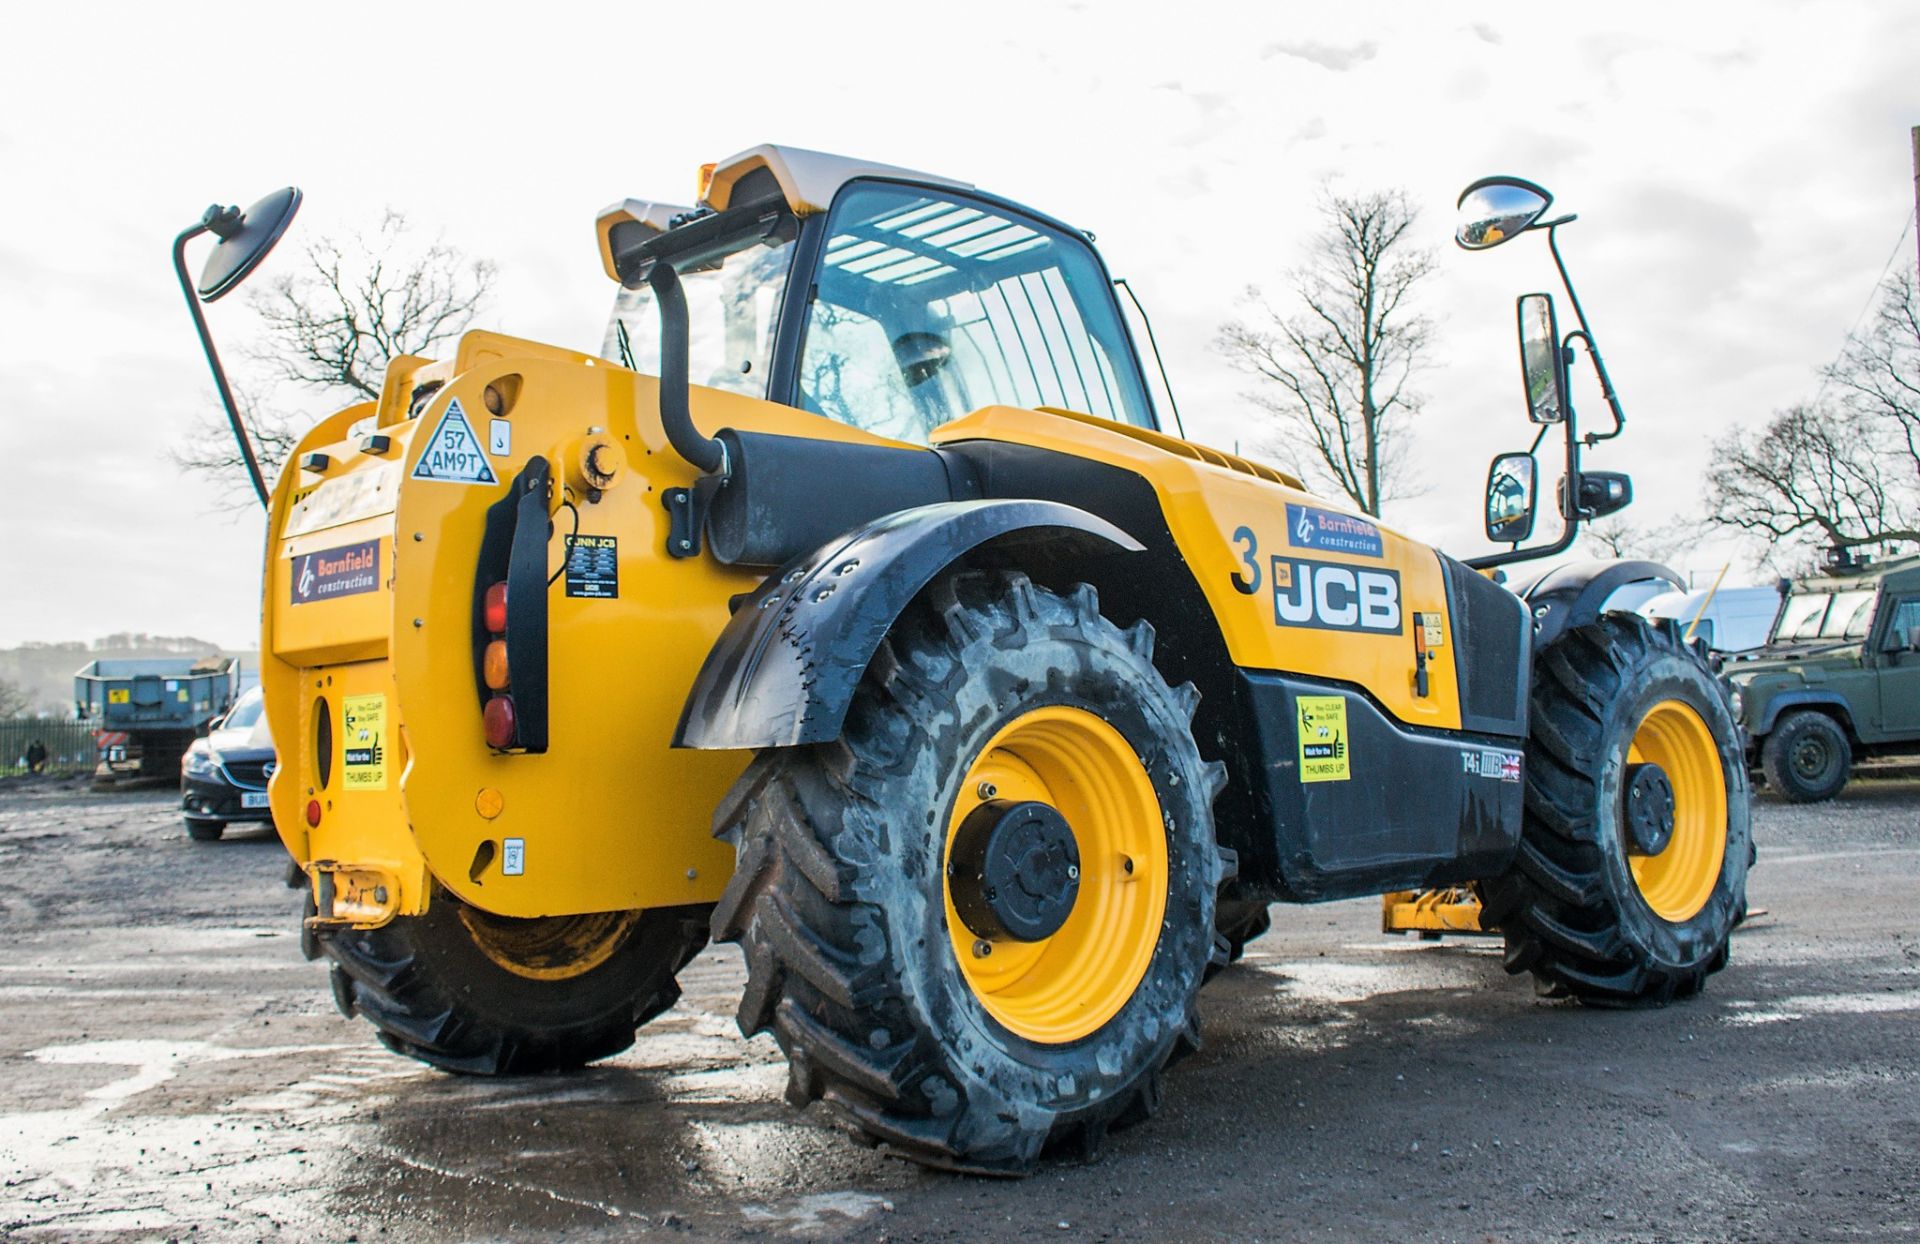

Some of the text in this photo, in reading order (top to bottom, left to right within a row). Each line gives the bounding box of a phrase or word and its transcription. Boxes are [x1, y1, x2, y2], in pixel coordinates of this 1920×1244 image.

[444, 430, 466, 450] 57
[432, 450, 478, 472] AM9T
[1319, 515, 1376, 537] Barnfield
[597, 538, 616, 548] JCB
[1320, 535, 1377, 551] construction
[317, 547, 374, 577] Barnfield
[1230, 525, 1262, 596] 3
[317, 574, 374, 594] construction
[1276, 564, 1401, 630] JCB
[1305, 763, 1345, 775] THUMBS UP
[1461, 751, 1480, 774] T4i
[346, 771, 383, 782] THUMBS UP
